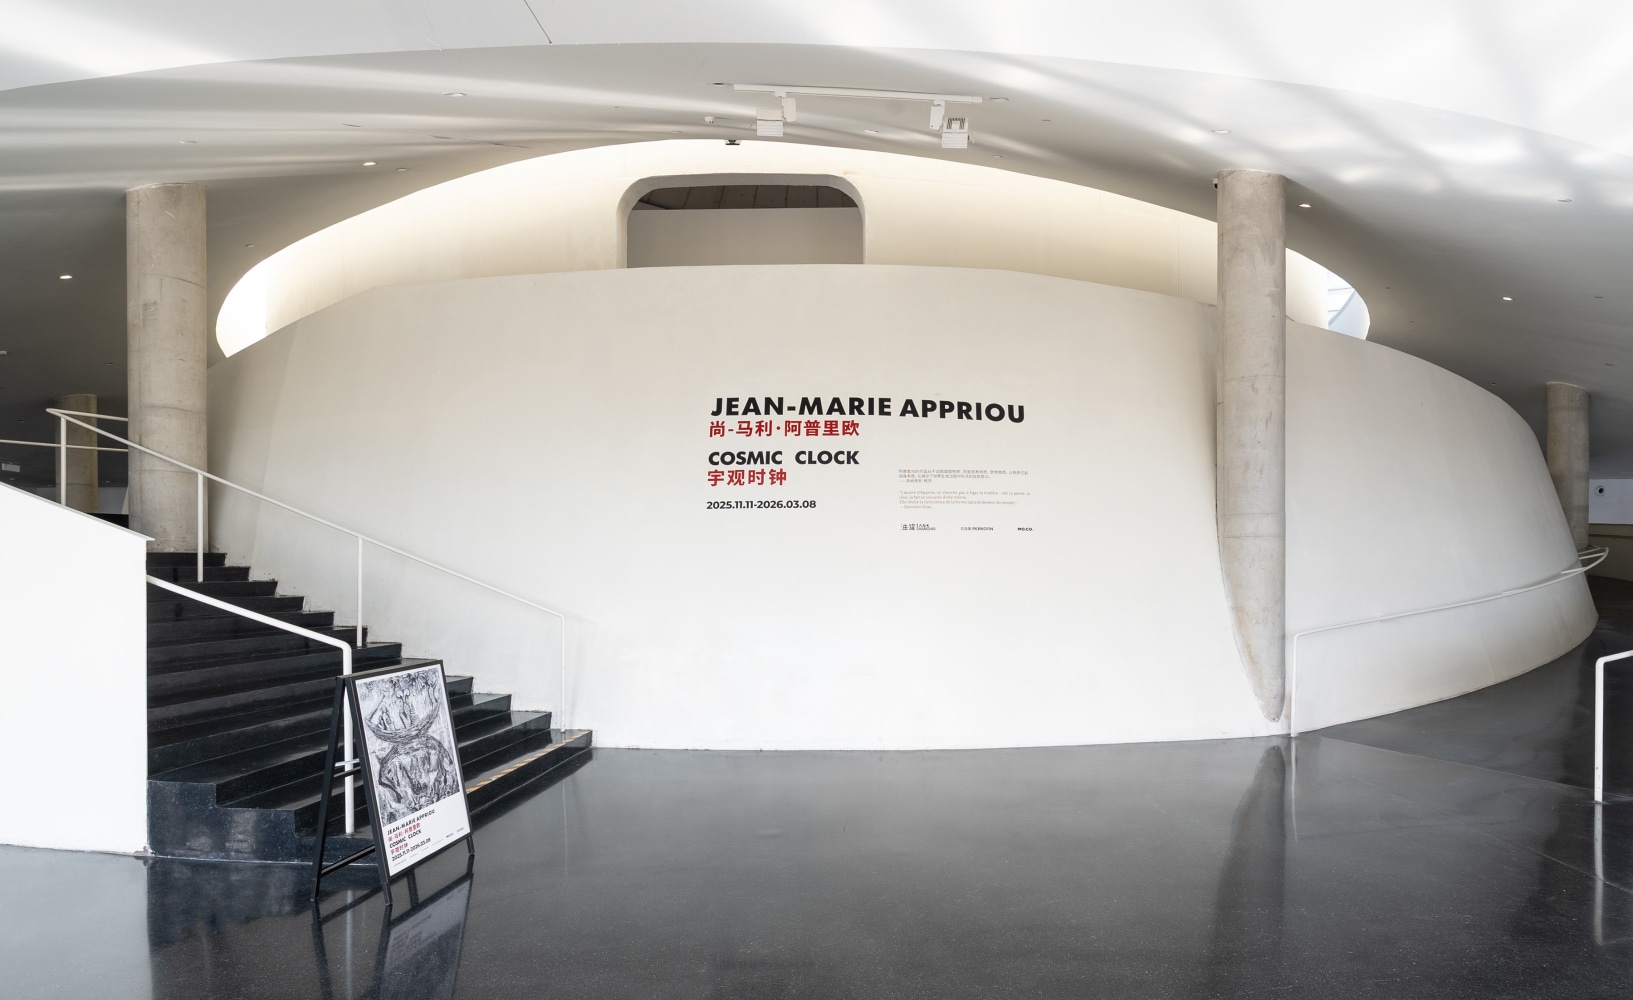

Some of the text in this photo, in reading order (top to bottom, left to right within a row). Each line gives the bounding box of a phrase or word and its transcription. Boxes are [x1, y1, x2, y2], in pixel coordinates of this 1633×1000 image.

[710, 397, 1025, 423] JEAN-MARIE APPRIOU
[709, 420, 860, 438] 尚-马利·阿普里欧
[708, 450, 860, 466] COSMIC CLOCK
[707, 468, 787, 487] 宇观时钟
[706, 500, 817, 510] 2025.11.11-2026.03.08
[387, 817, 416, 835] JEAN-MARIE
[407, 829, 422, 839] CLOCK
